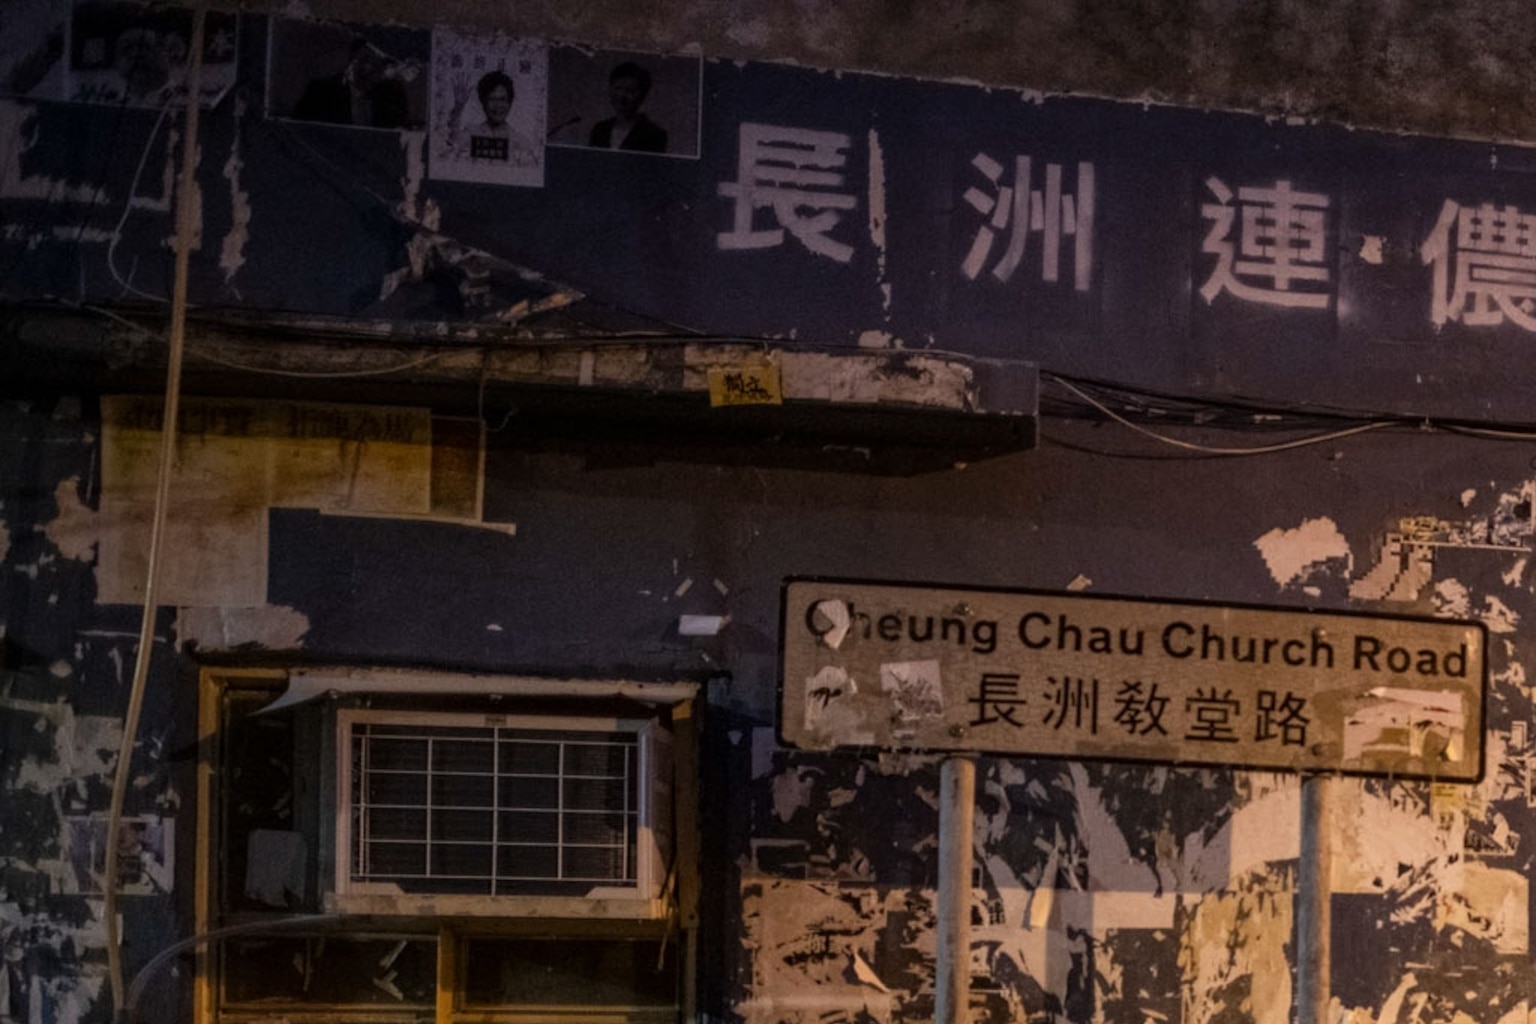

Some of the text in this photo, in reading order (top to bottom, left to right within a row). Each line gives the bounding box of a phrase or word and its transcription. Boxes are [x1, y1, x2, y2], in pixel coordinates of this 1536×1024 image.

[1018, 611, 1145, 656] Chau
[1162, 621, 1335, 666] Church
[1353, 634, 1467, 679] Road
